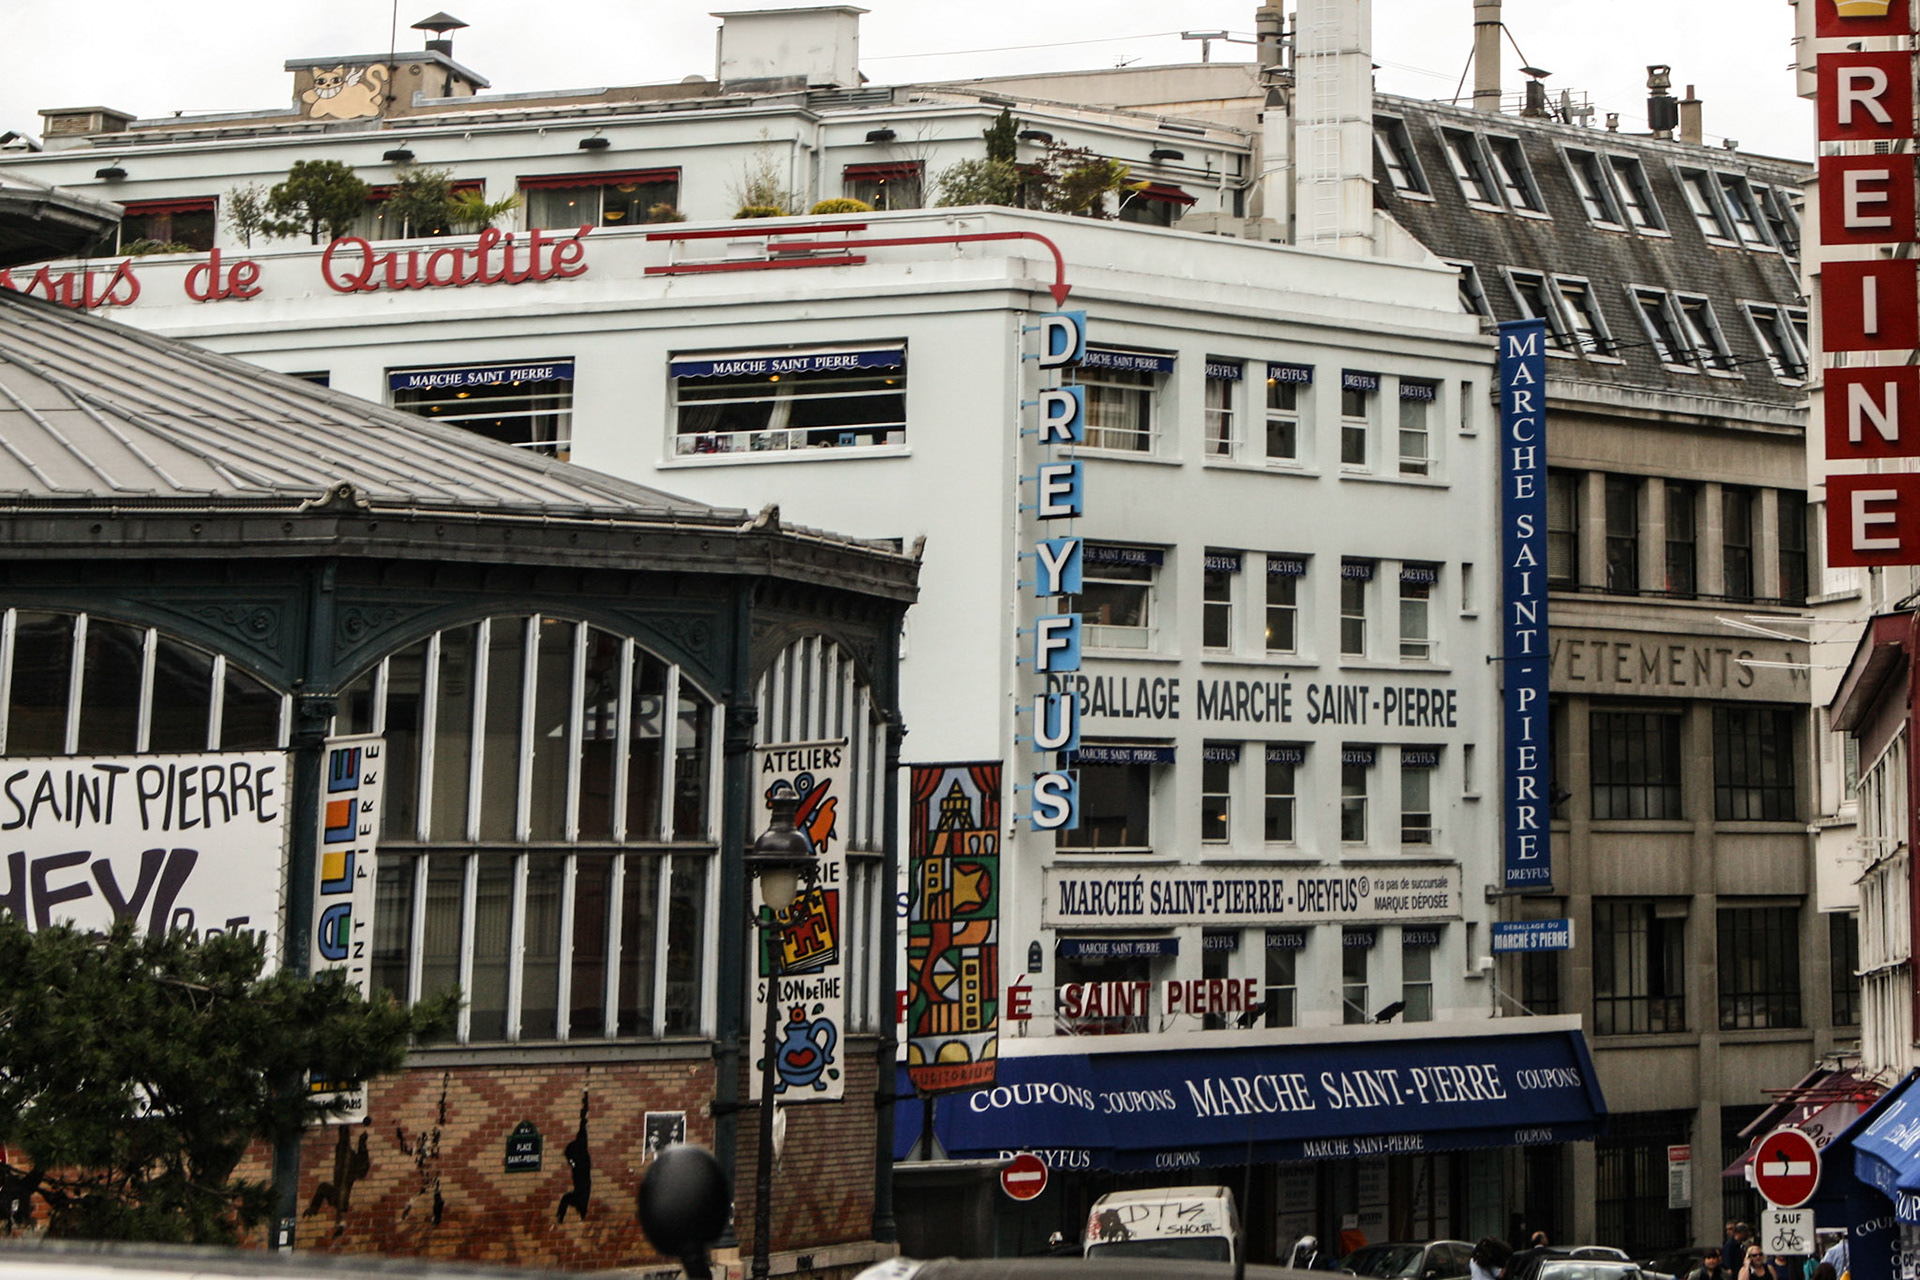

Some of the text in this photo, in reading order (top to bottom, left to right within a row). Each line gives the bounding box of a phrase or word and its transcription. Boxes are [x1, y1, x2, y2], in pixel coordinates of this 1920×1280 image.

[185, 248, 263, 302] de
[321, 224, 595, 294] Qualité
[1837, 66, 1900, 550] REINE
[713, 355, 858, 374] MARCHE SAINT PIERRE
[1113, 356, 1133, 367] SAINT
[1135, 357, 1159, 369] PIERRE
[410, 368, 553, 386] MARCHE SAINT PIERRE
[1270, 367, 1308, 381] DREYFUS
[1344, 375, 1376, 388] DREYFUS
[1400, 384, 1432, 398] DREYFUS
[1507, 332, 1538, 499] MARCHE
[1099, 548, 1118, 560] SAINT
[1122, 549, 1146, 561] PIERRE
[1032, 315, 1079, 828] DREYFUS
[1267, 560, 1303, 572] DREYFUS
[1342, 565, 1370, 577] REYFUS
[1401, 568, 1434, 581] DREYFUS
[1549, 640, 1755, 688] VETEMENTS
[1198, 673, 1292, 722] MARCHÉ
[762, 749, 841, 773] ATELIERS
[1078, 748, 1158, 761] MARCHE SAINT PIERRE
[1266, 750, 1301, 762] DREYFUS
[1342, 751, 1372, 763] REYFUS
[1402, 752, 1436, 763] DREYFUS
[2, 762, 277, 831] SAINT PIERRE
[357, 745, 380, 878] PIERRE
[316, 747, 361, 975] ALLE
[1507, 867, 1549, 879] DREYFUS
[1386, 880, 1398, 891] pas
[1401, 877, 1410, 889] de
[1411, 876, 1448, 888] succursale
[1059, 874, 1144, 916] MARCHÉ
[1375, 891, 1448, 913] MARQUE DÉPOSÉE
[1266, 933, 1303, 947] DREYFUS
[1342, 933, 1373, 945] REYFUS
[1402, 931, 1436, 943] DREYFUS
[1494, 931, 1528, 950] MARCHÉ
[1079, 941, 1161, 954] MARCHE SAINT PIERRE
[757, 979, 804, 1003] SLON
[1060, 982, 1151, 1019] SAINT
[1163, 978, 1257, 1015] PIERRE
[910, 1065, 996, 1087] AUDITORIUM
[969, 1064, 1581, 1117] COUPONS COUPONS MARCHE SAINT-PIERRE COUPONS
[516, 1143, 532, 1151] PLACE
[1156, 1151, 1200, 1167] COUPONS
[1303, 1137, 1350, 1157] MARCHE
[1353, 1134, 1425, 1155] SAINT-PIERRE
[1515, 1129, 1552, 1143] COUPONS
[1774, 1213, 1802, 1225] SAUF
